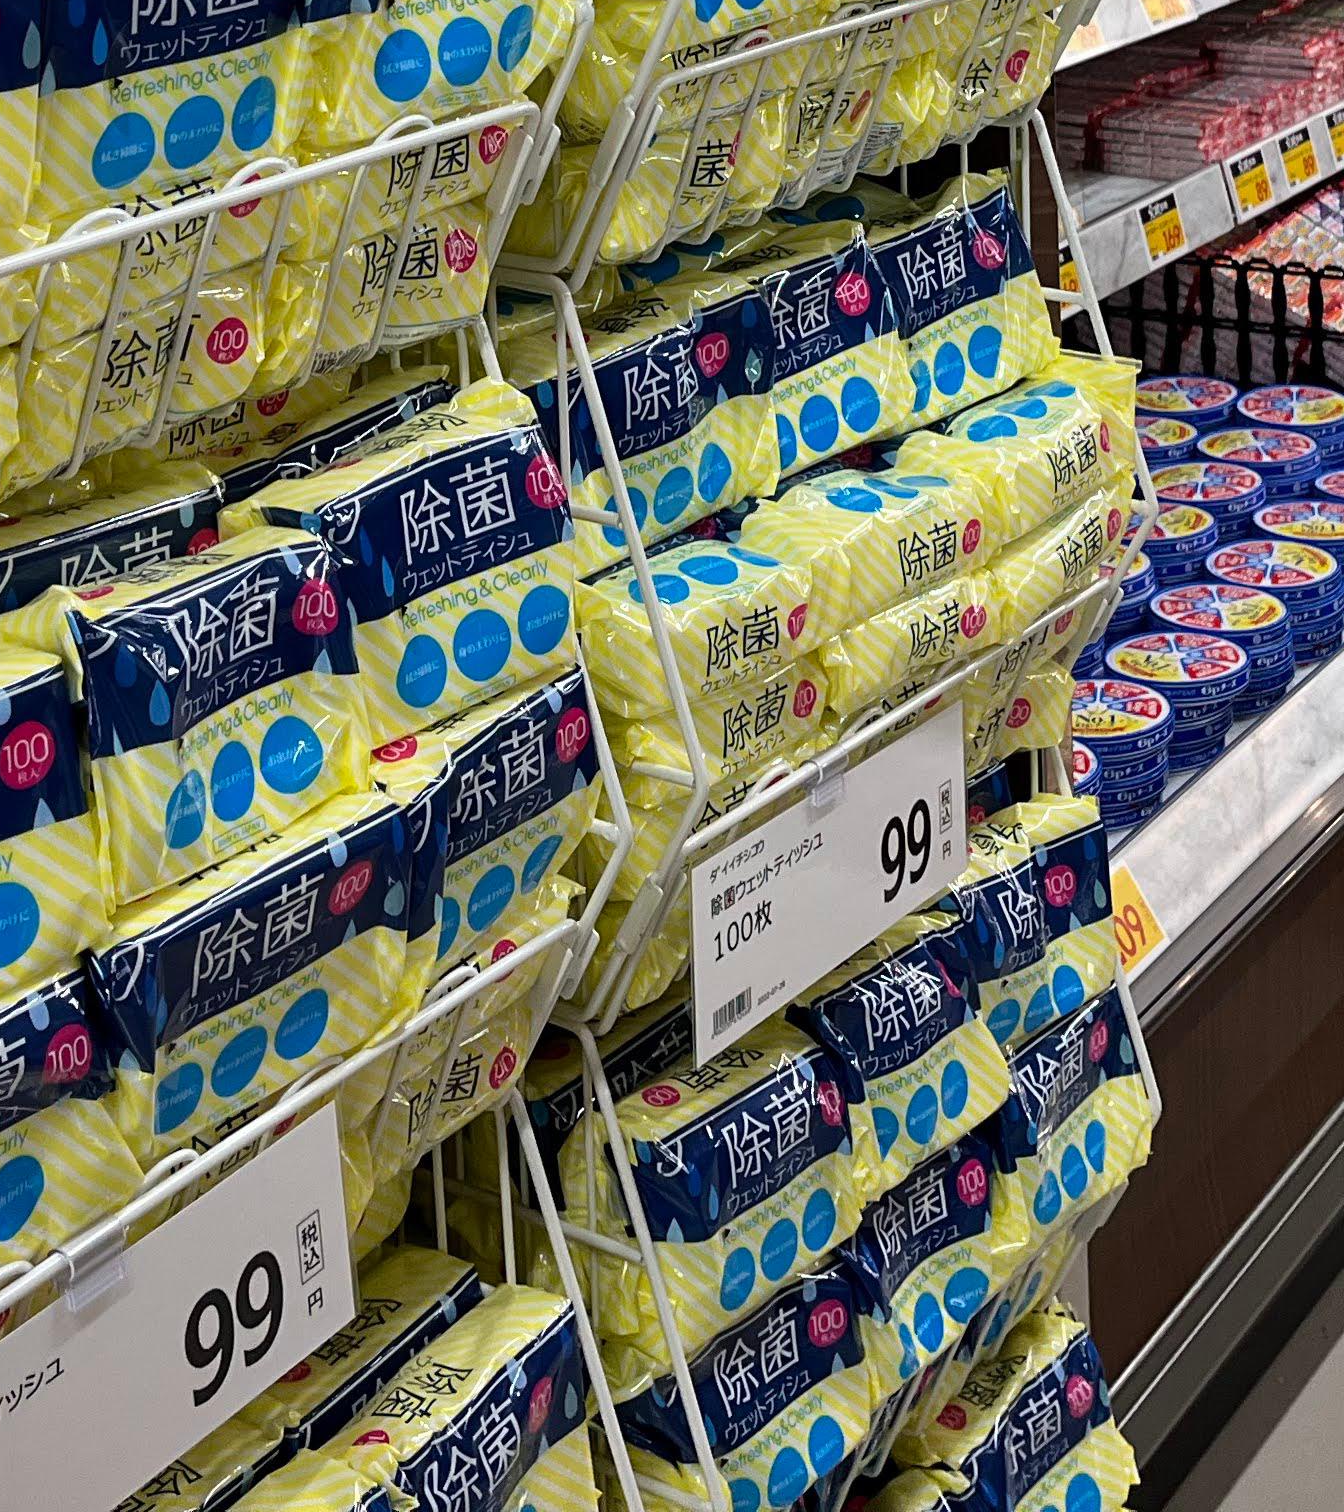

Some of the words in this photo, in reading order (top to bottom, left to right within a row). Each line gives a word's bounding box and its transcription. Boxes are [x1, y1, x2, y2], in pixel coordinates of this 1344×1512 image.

[119, 18, 269, 70] ウェットティシュ
[902, 226, 967, 304] 除菌
[212, 329, 244, 354] 100
[695, 340, 728, 365] 100
[399, 455, 516, 565] 除菌
[401, 533, 535, 598] ウェットティシュ
[897, 521, 960, 587] 除菌
[170, 575, 279, 692] 除菌
[297, 588, 337, 619] 100
[704, 604, 779, 677] 除菌
[179, 656, 286, 728] ウェットティシュ
[721, 684, 788, 760] 除菌
[3, 733, 51, 773] 100
[558, 717, 587, 747] 100
[455, 719, 546, 823] 除菌
[332, 865, 372, 903] 100
[709, 838, 765, 884] ダイイチシコウ
[881, 798, 931, 904] 99
[942, 840, 952, 861] 円
[1044, 871, 1074, 896] 100
[190, 872, 326, 1000] 除菌
[713, 899, 773, 962] 100枚
[178, 942, 319, 1027] ウェットティシュ
[860, 959, 943, 1051] 除菌
[723, 1086, 811, 1190] 除菌
[872, 1167, 948, 1260] 除菌
[957, 1169, 986, 1193] 100
[302, 1217, 324, 1273] 税込
[184, 1250, 284, 1407] 99
[307, 1286, 325, 1317] 円
[809, 1306, 846, 1334] 100
[714, 1306, 799, 1419] 除菌
[724, 1370, 811, 1447] ウェットティシュ
[424, 1394, 523, 1512] 除菌
